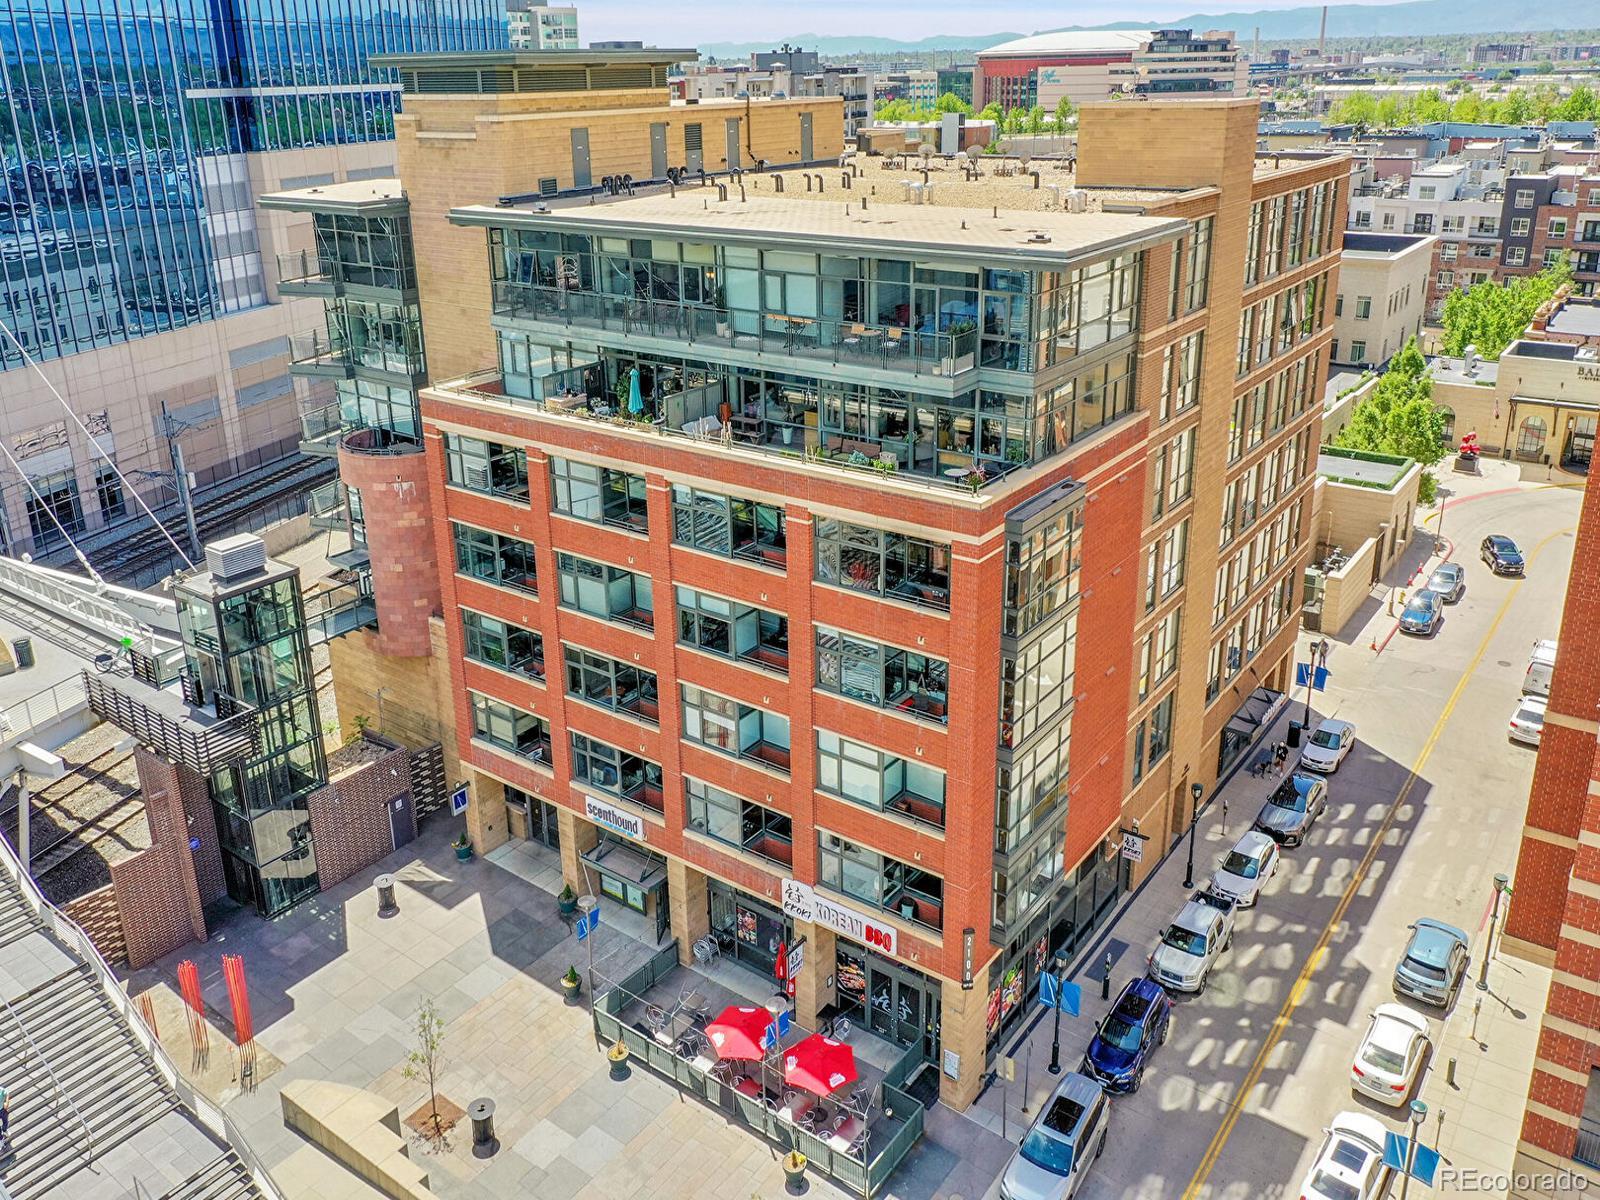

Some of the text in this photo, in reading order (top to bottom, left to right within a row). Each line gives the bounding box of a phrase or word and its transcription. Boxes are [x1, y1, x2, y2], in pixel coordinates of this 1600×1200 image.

[587, 803, 638, 834] scenthound
[816, 901, 893, 953] KOREAN BBQ
